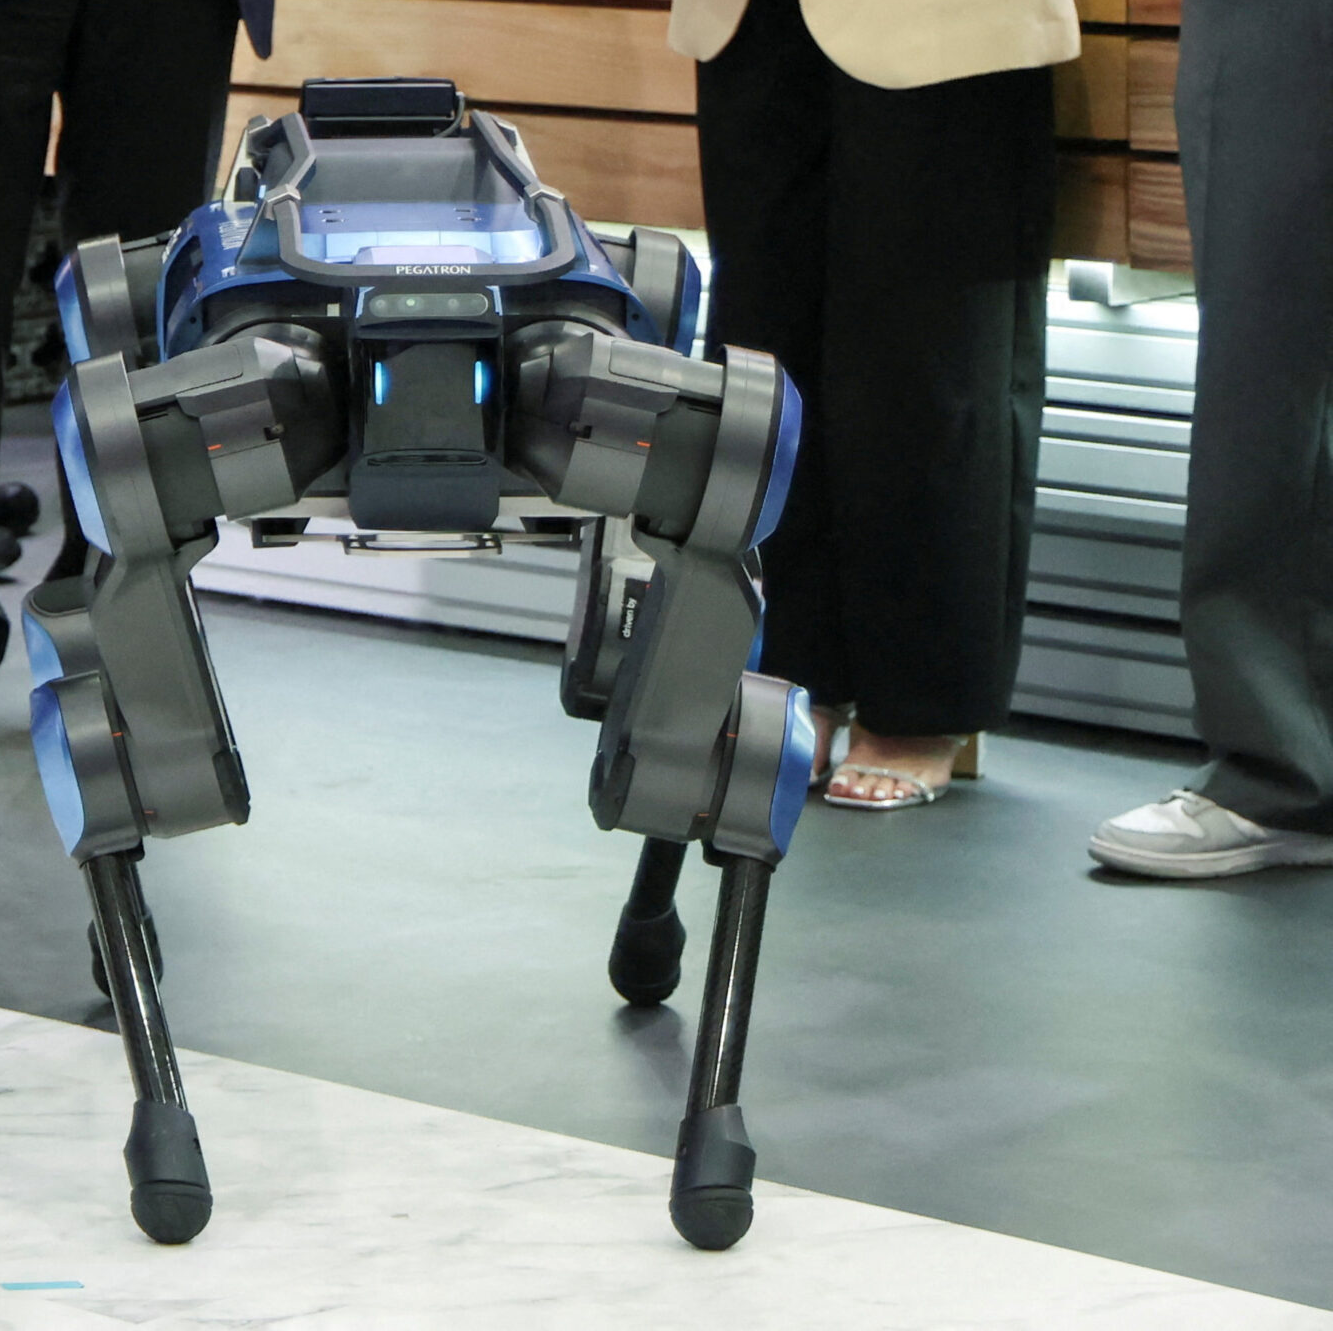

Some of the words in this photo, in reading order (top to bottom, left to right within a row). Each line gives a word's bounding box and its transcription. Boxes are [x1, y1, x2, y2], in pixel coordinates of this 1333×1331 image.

[395, 265, 471, 276] PEGATRON
[626, 597, 638, 609] by
[622, 609, 635, 638] driven
